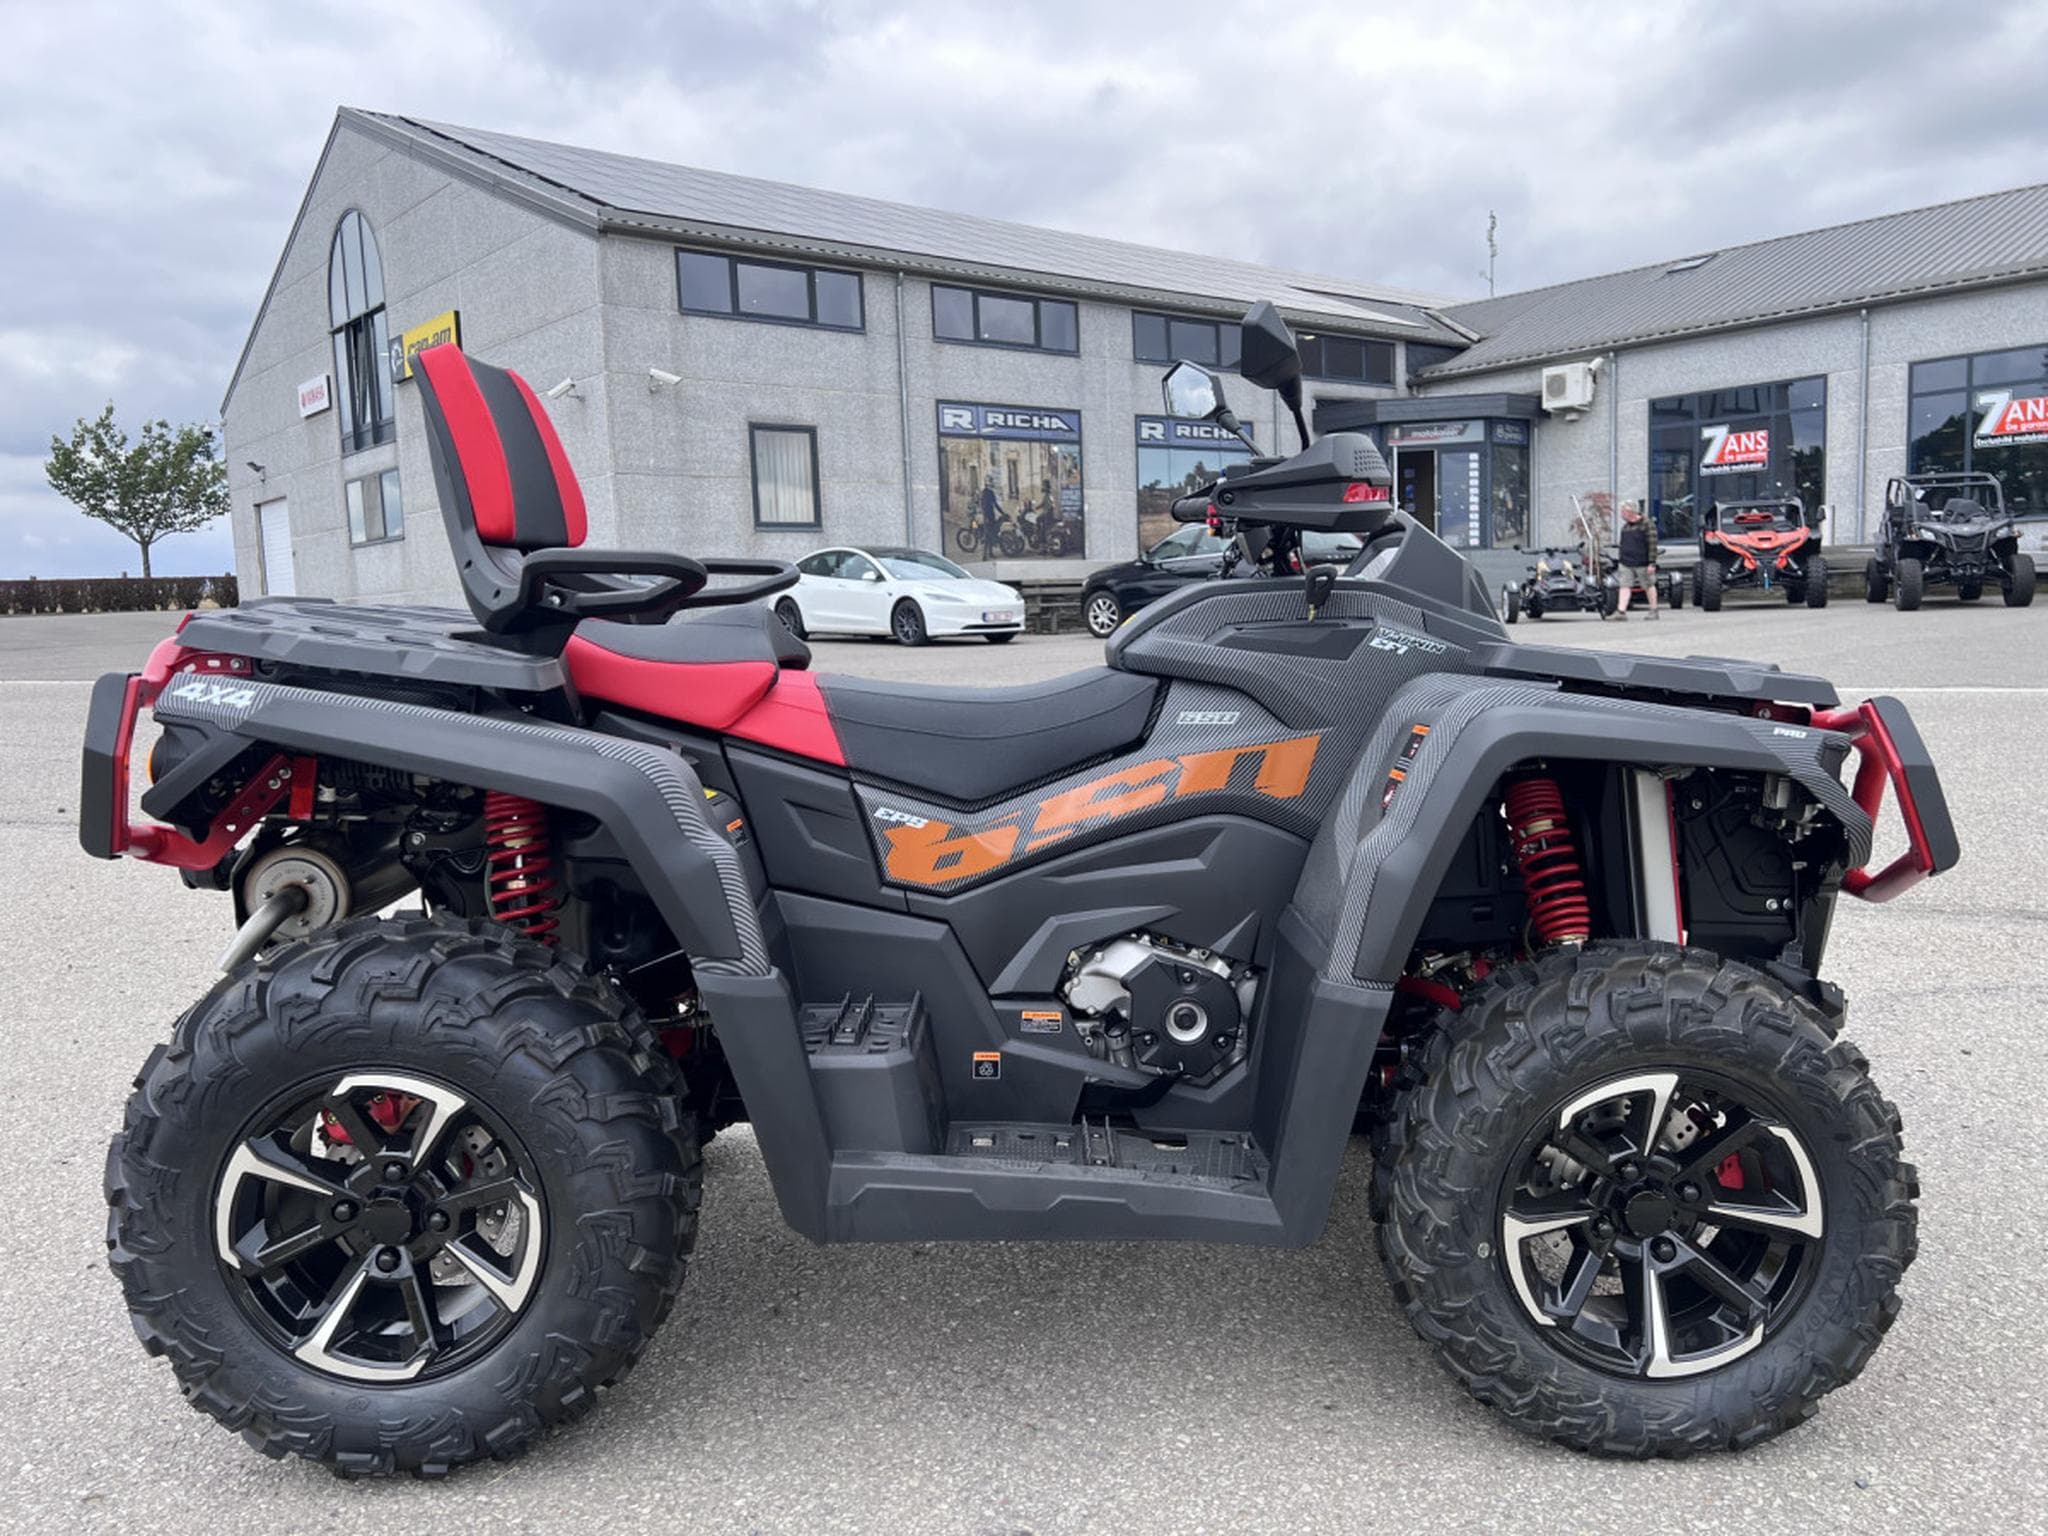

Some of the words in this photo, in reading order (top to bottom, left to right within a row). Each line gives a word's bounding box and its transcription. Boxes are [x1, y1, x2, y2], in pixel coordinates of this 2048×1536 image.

[943, 408, 975, 430] R
[985, 412, 1071, 431] RICHA
[2006, 398, 2048, 421] AN
[1140, 421, 1166, 440] R
[1724, 430, 1767, 452] ANS
[1369, 637, 1409, 655] EFI
[1773, 727, 1808, 739] PRO
[873, 807, 929, 829] EPS
